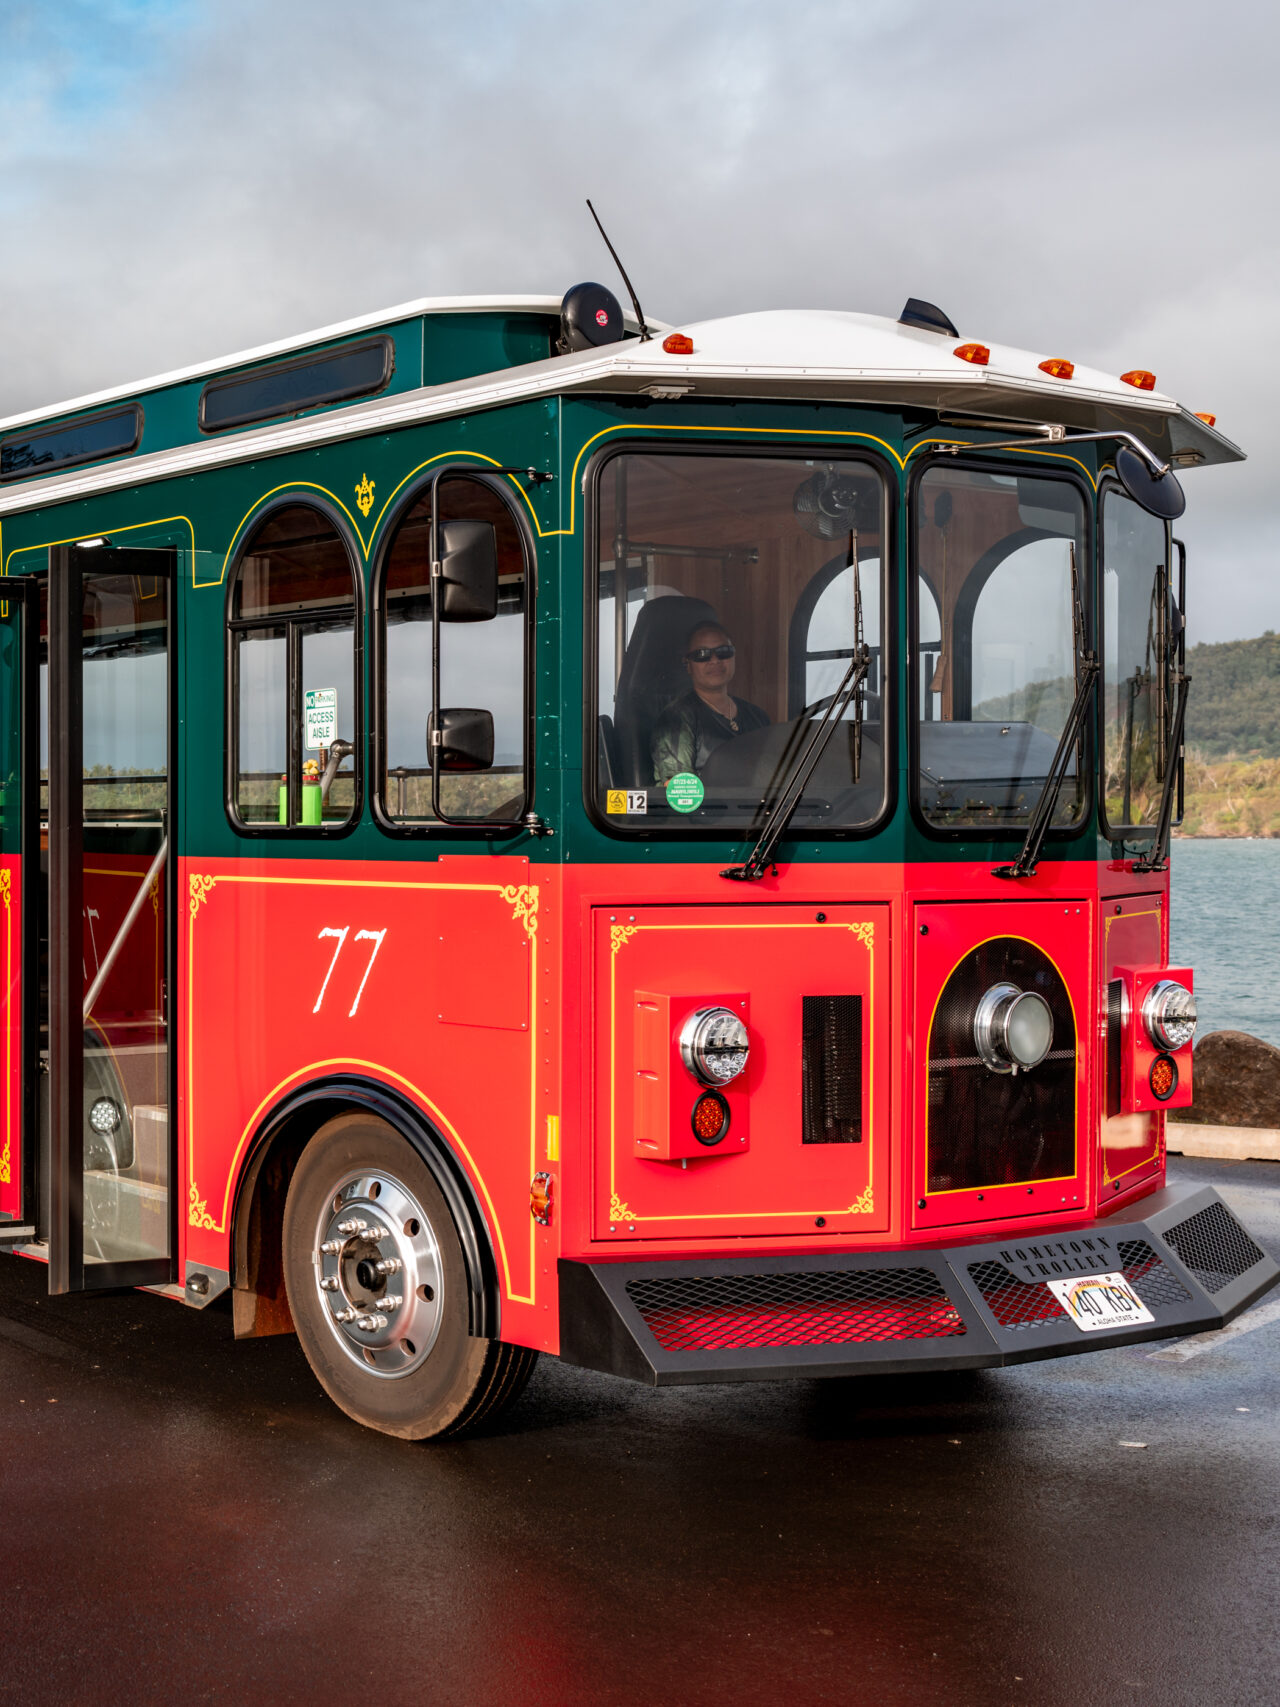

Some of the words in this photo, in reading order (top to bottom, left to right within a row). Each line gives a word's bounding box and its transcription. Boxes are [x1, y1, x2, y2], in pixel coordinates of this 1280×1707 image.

[306, 695, 315, 707] NO
[308, 711, 334, 724] ACCESS
[312, 727, 330, 739] AISLE
[628, 795, 645, 809] 12
[312, 925, 388, 1018] 77
[999, 1237, 1111, 1263] HOMETOWN
[1023, 1254, 1109, 1277] TROLLEY
[1062, 1290, 1103, 1318] 140
[1097, 1317, 1116, 1325] ALOHA
[1115, 1314, 1134, 1323] STATE
